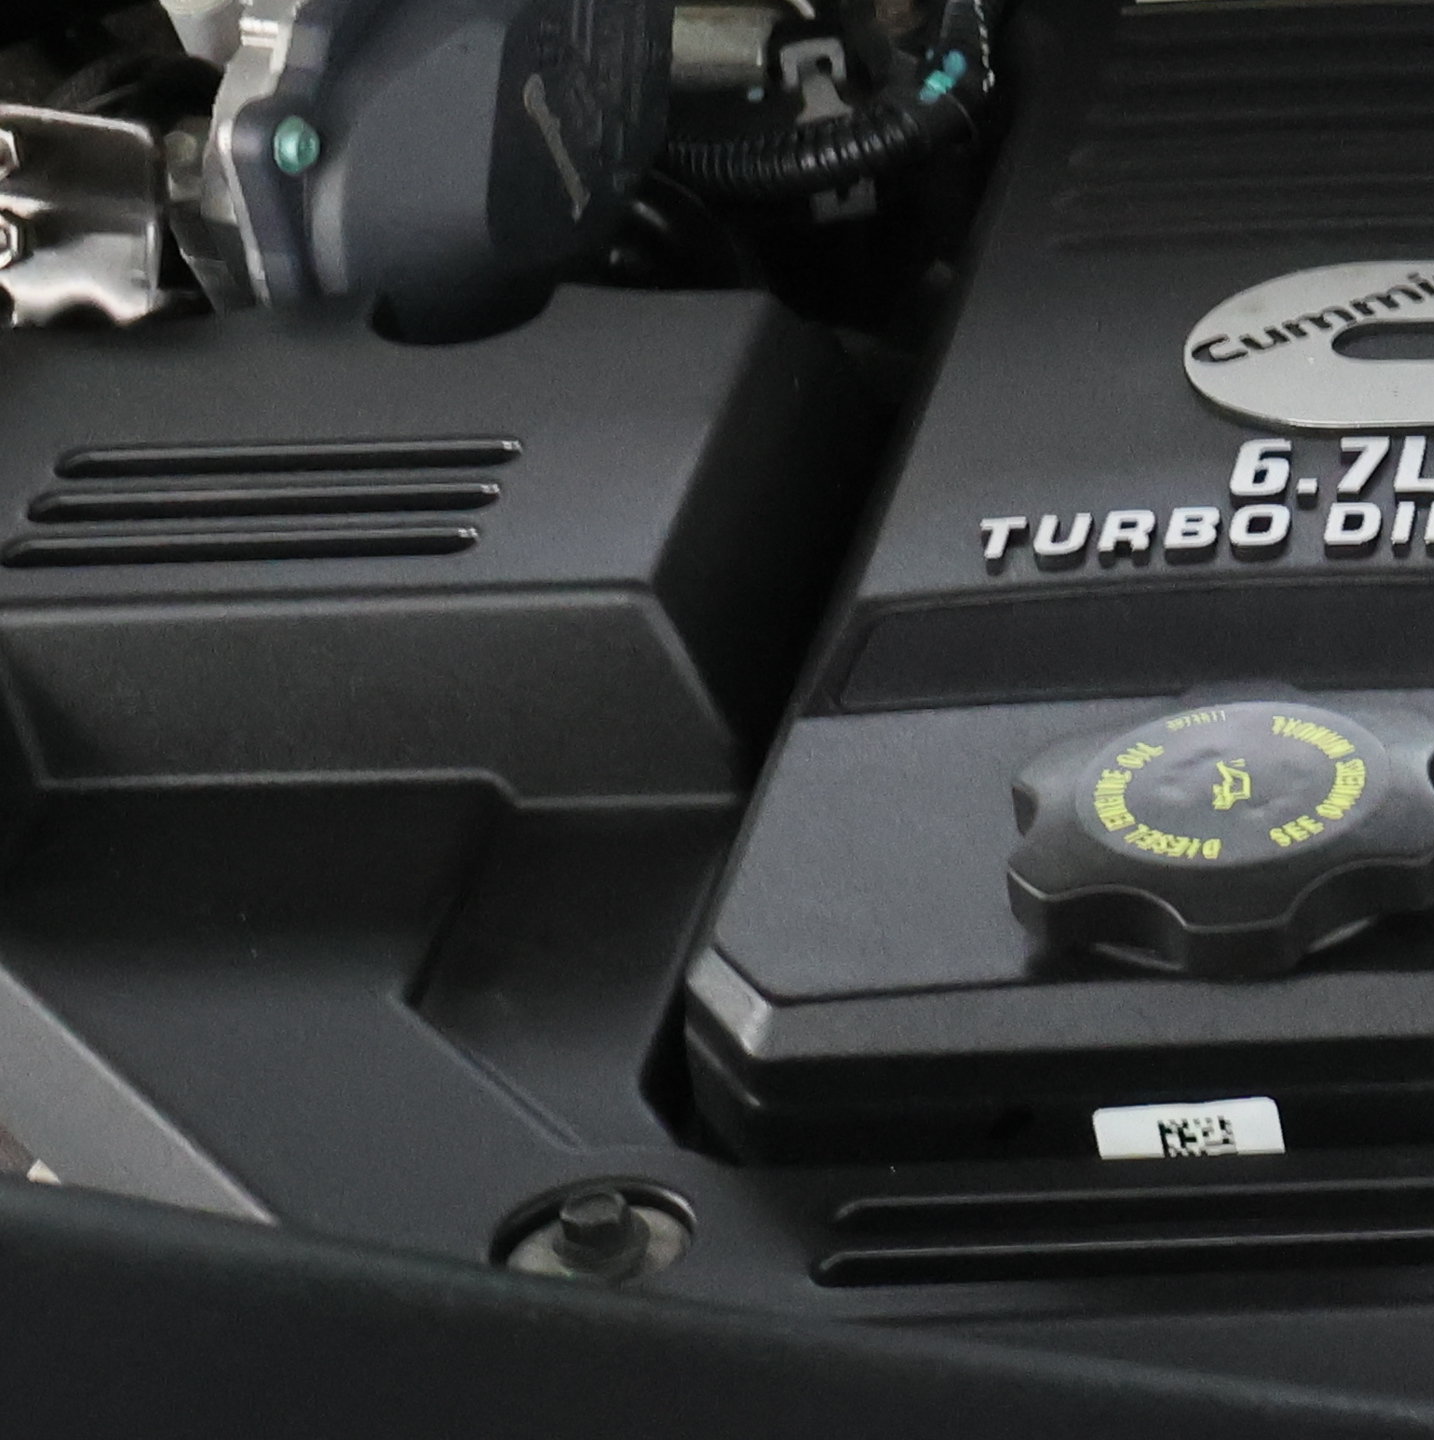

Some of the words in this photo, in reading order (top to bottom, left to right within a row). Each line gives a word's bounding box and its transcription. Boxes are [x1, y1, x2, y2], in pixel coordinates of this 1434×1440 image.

[979, 502, 1294, 561] TURBO
[1115, 741, 1165, 771] OIL
[1271, 714, 1355, 760] MANUAL
[1093, 768, 1136, 832] ENGINE
[1123, 822, 1224, 861] DIESEL
[1268, 813, 1325, 848] SEE
